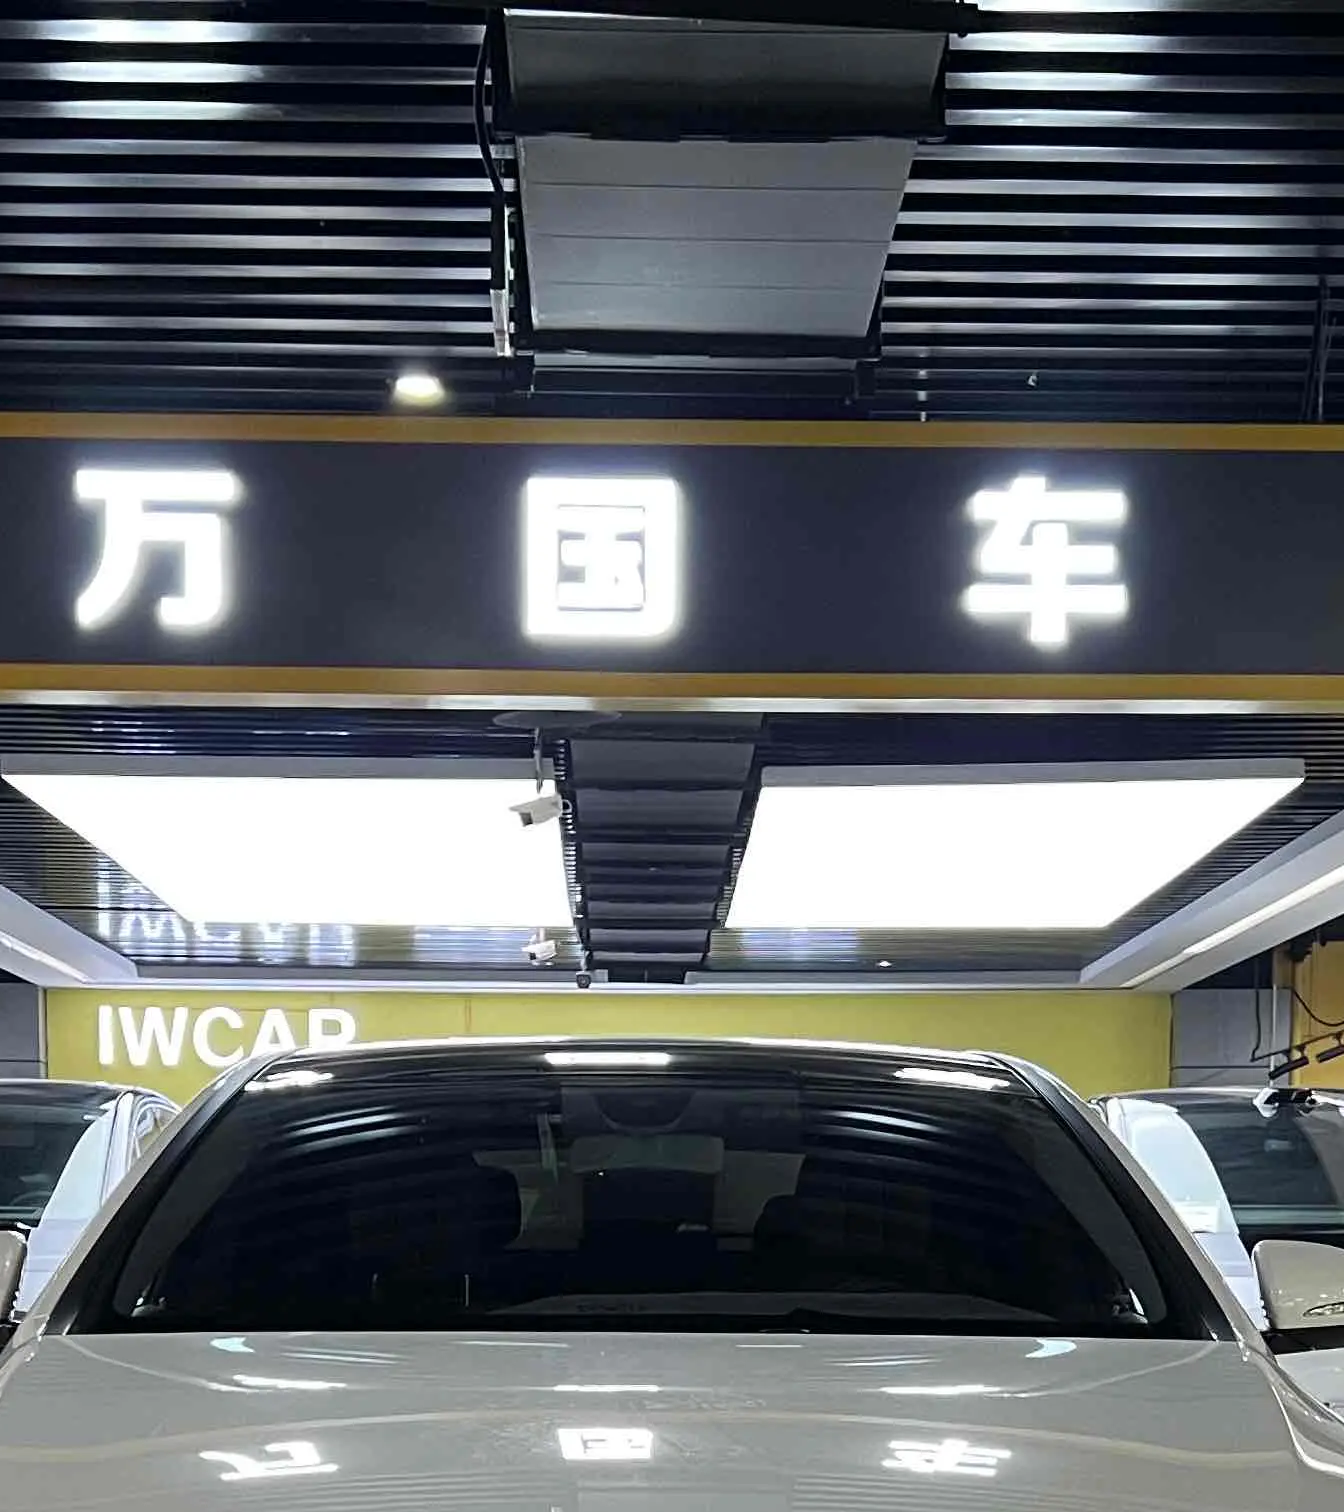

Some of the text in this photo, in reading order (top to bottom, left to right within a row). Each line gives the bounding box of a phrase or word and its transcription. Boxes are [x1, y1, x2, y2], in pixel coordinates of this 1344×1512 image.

[73, 468, 1130, 647] 万国车
[97, 1004, 356, 1067] IWCAR
